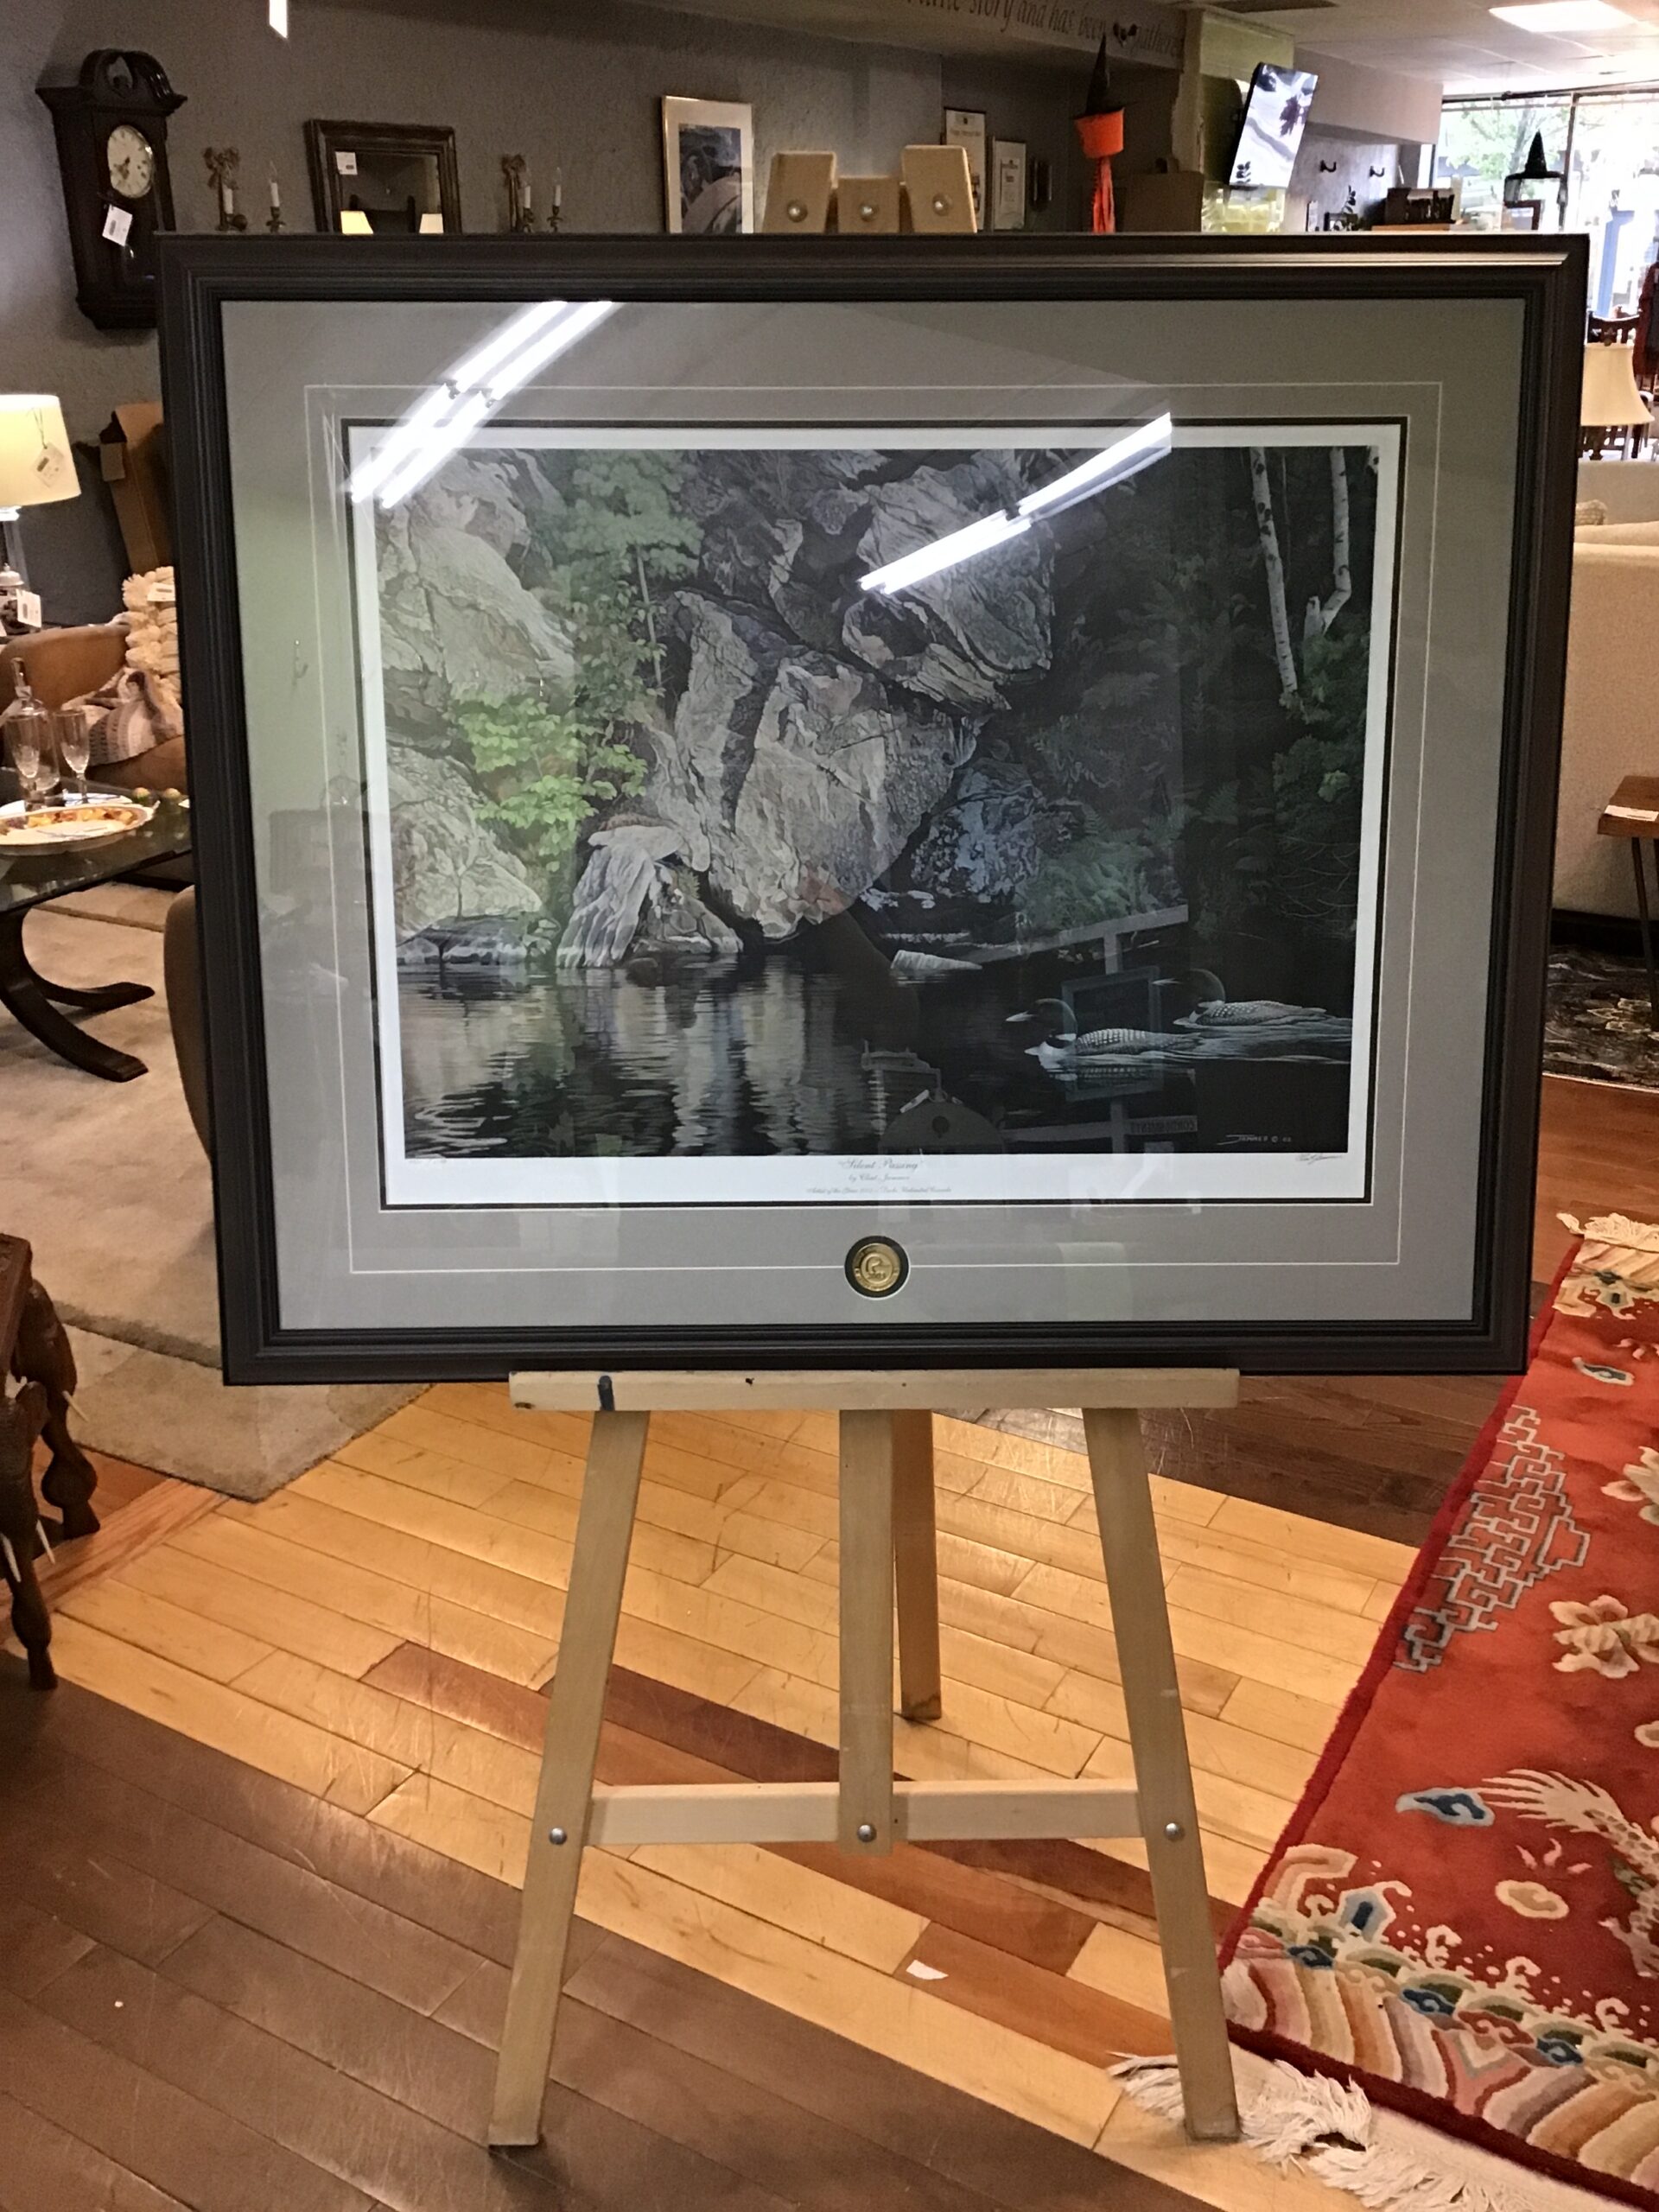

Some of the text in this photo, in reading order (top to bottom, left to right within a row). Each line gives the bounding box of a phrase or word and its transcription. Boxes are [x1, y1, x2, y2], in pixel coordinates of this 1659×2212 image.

[969, 0, 1014, 33] story
[1016, 0, 1048, 29] and
[1048, 0, 1077, 36] has
